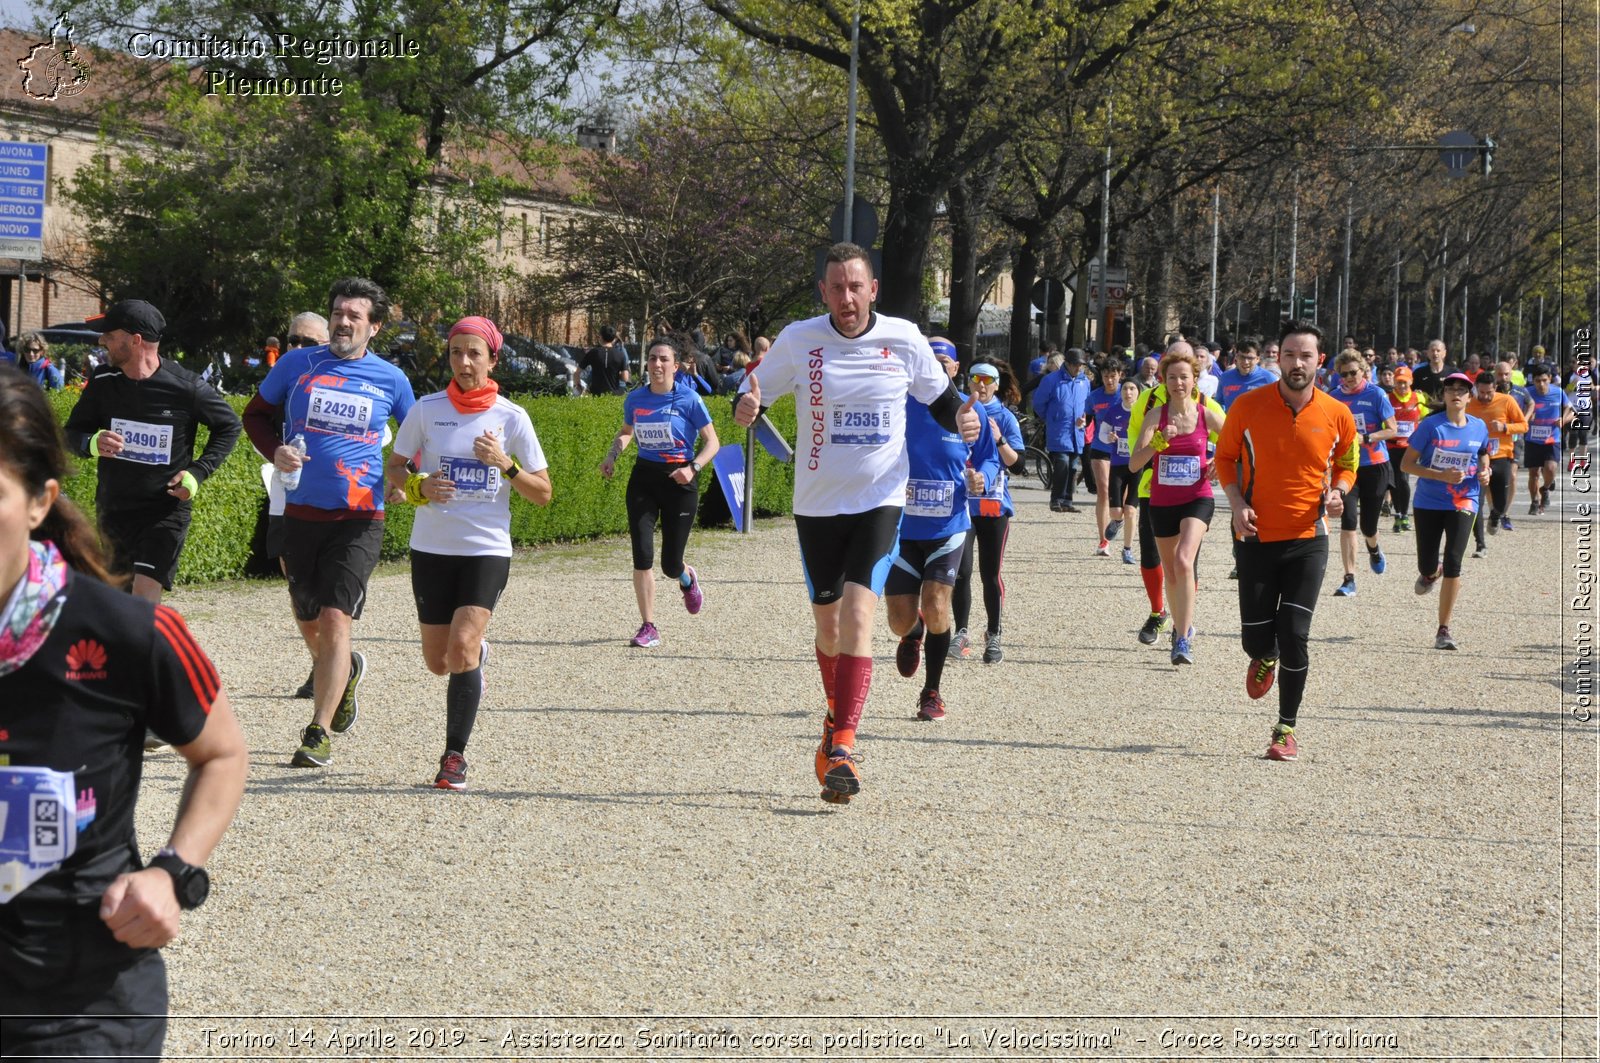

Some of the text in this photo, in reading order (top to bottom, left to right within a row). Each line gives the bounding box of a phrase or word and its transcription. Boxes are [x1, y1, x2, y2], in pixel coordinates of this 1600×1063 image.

[323, 400, 356, 419] 2429
[808, 347, 825, 471] CROCE ROSSA
[844, 412, 880, 427] 2535
[125, 431, 157, 448] 3490
[642, 429, 663, 439] 2020
[1168, 462, 1190, 473] 1286
[1440, 456, 1461, 466] 2985
[453, 467, 485, 483] 1449
[916, 488, 943, 501] 1506
[66, 671, 107, 680] HUAWEI
